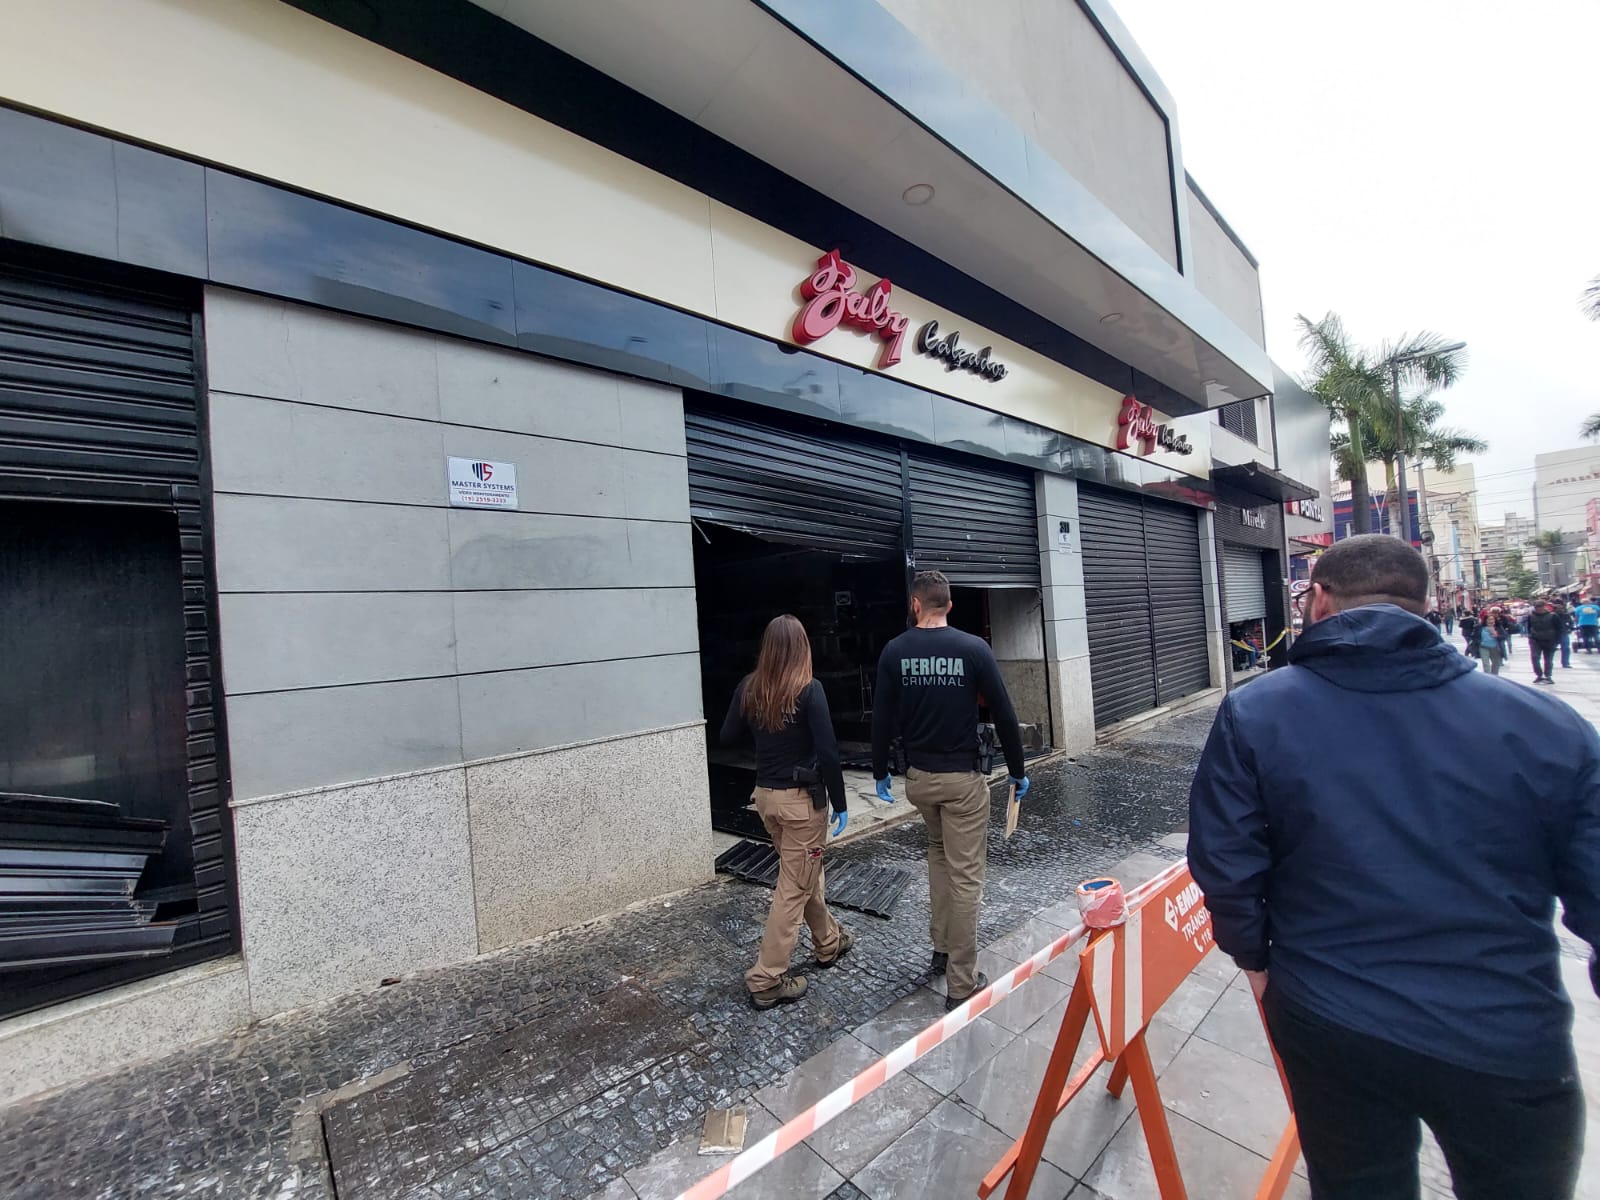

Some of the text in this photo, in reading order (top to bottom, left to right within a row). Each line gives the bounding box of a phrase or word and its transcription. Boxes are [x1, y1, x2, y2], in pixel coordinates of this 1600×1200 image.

[483, 483, 515, 491] SYSTEMS
[900, 656, 965, 676] PERÍCIA
[901, 676, 966, 687] CRIMINAL
[1181, 905, 1212, 942] TRÂNSIT
